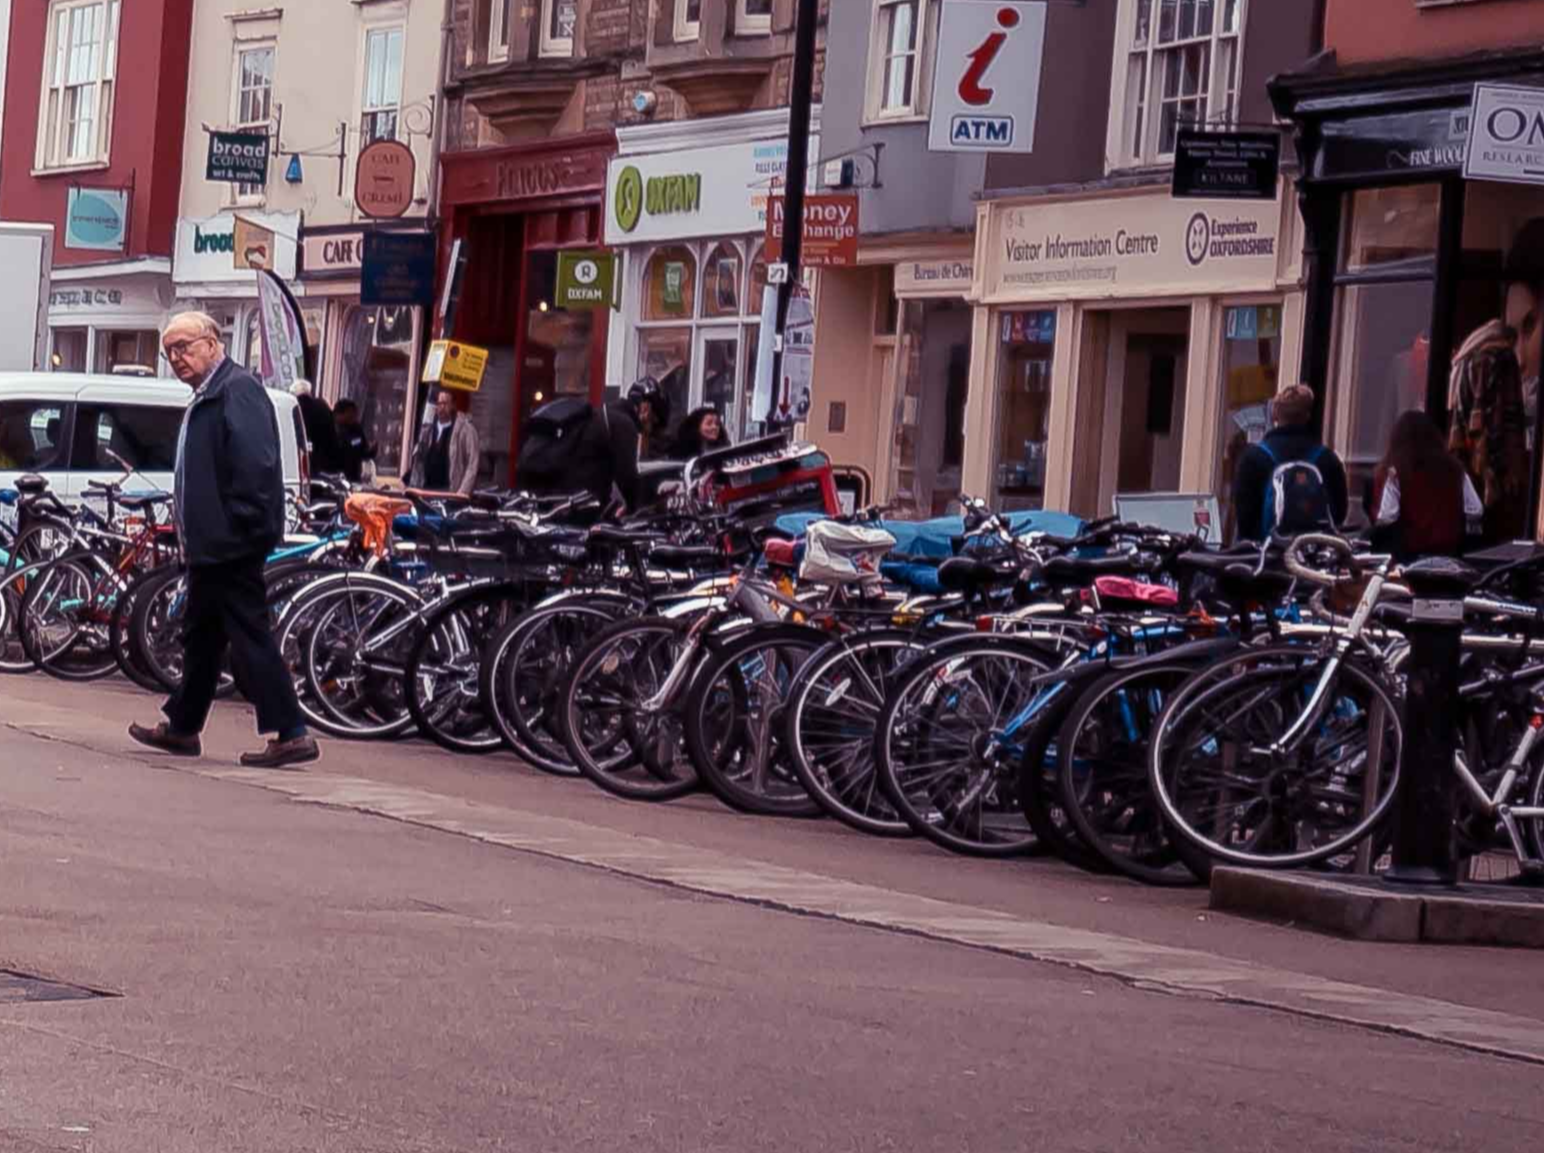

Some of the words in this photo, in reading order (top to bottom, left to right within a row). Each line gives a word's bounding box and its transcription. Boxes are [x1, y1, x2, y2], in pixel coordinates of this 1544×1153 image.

[954, 120, 1008, 140] ATM
[212, 136, 266, 158] broad
[211, 154, 265, 170] canvas
[212, 169, 226, 178] art
[645, 173, 701, 215] OXFAM
[774, 200, 851, 224] Mney
[773, 222, 854, 241] Ehange
[1210, 216, 1258, 238] Experience
[1006, 236, 1042, 262] Visitor
[1045, 232, 1112, 259] Information
[1115, 229, 1159, 255] Centre
[1209, 236, 1275, 257] OXFORDSHIRE
[952, 262, 974, 280] Chan
[568, 288, 602, 301] OXFAM
